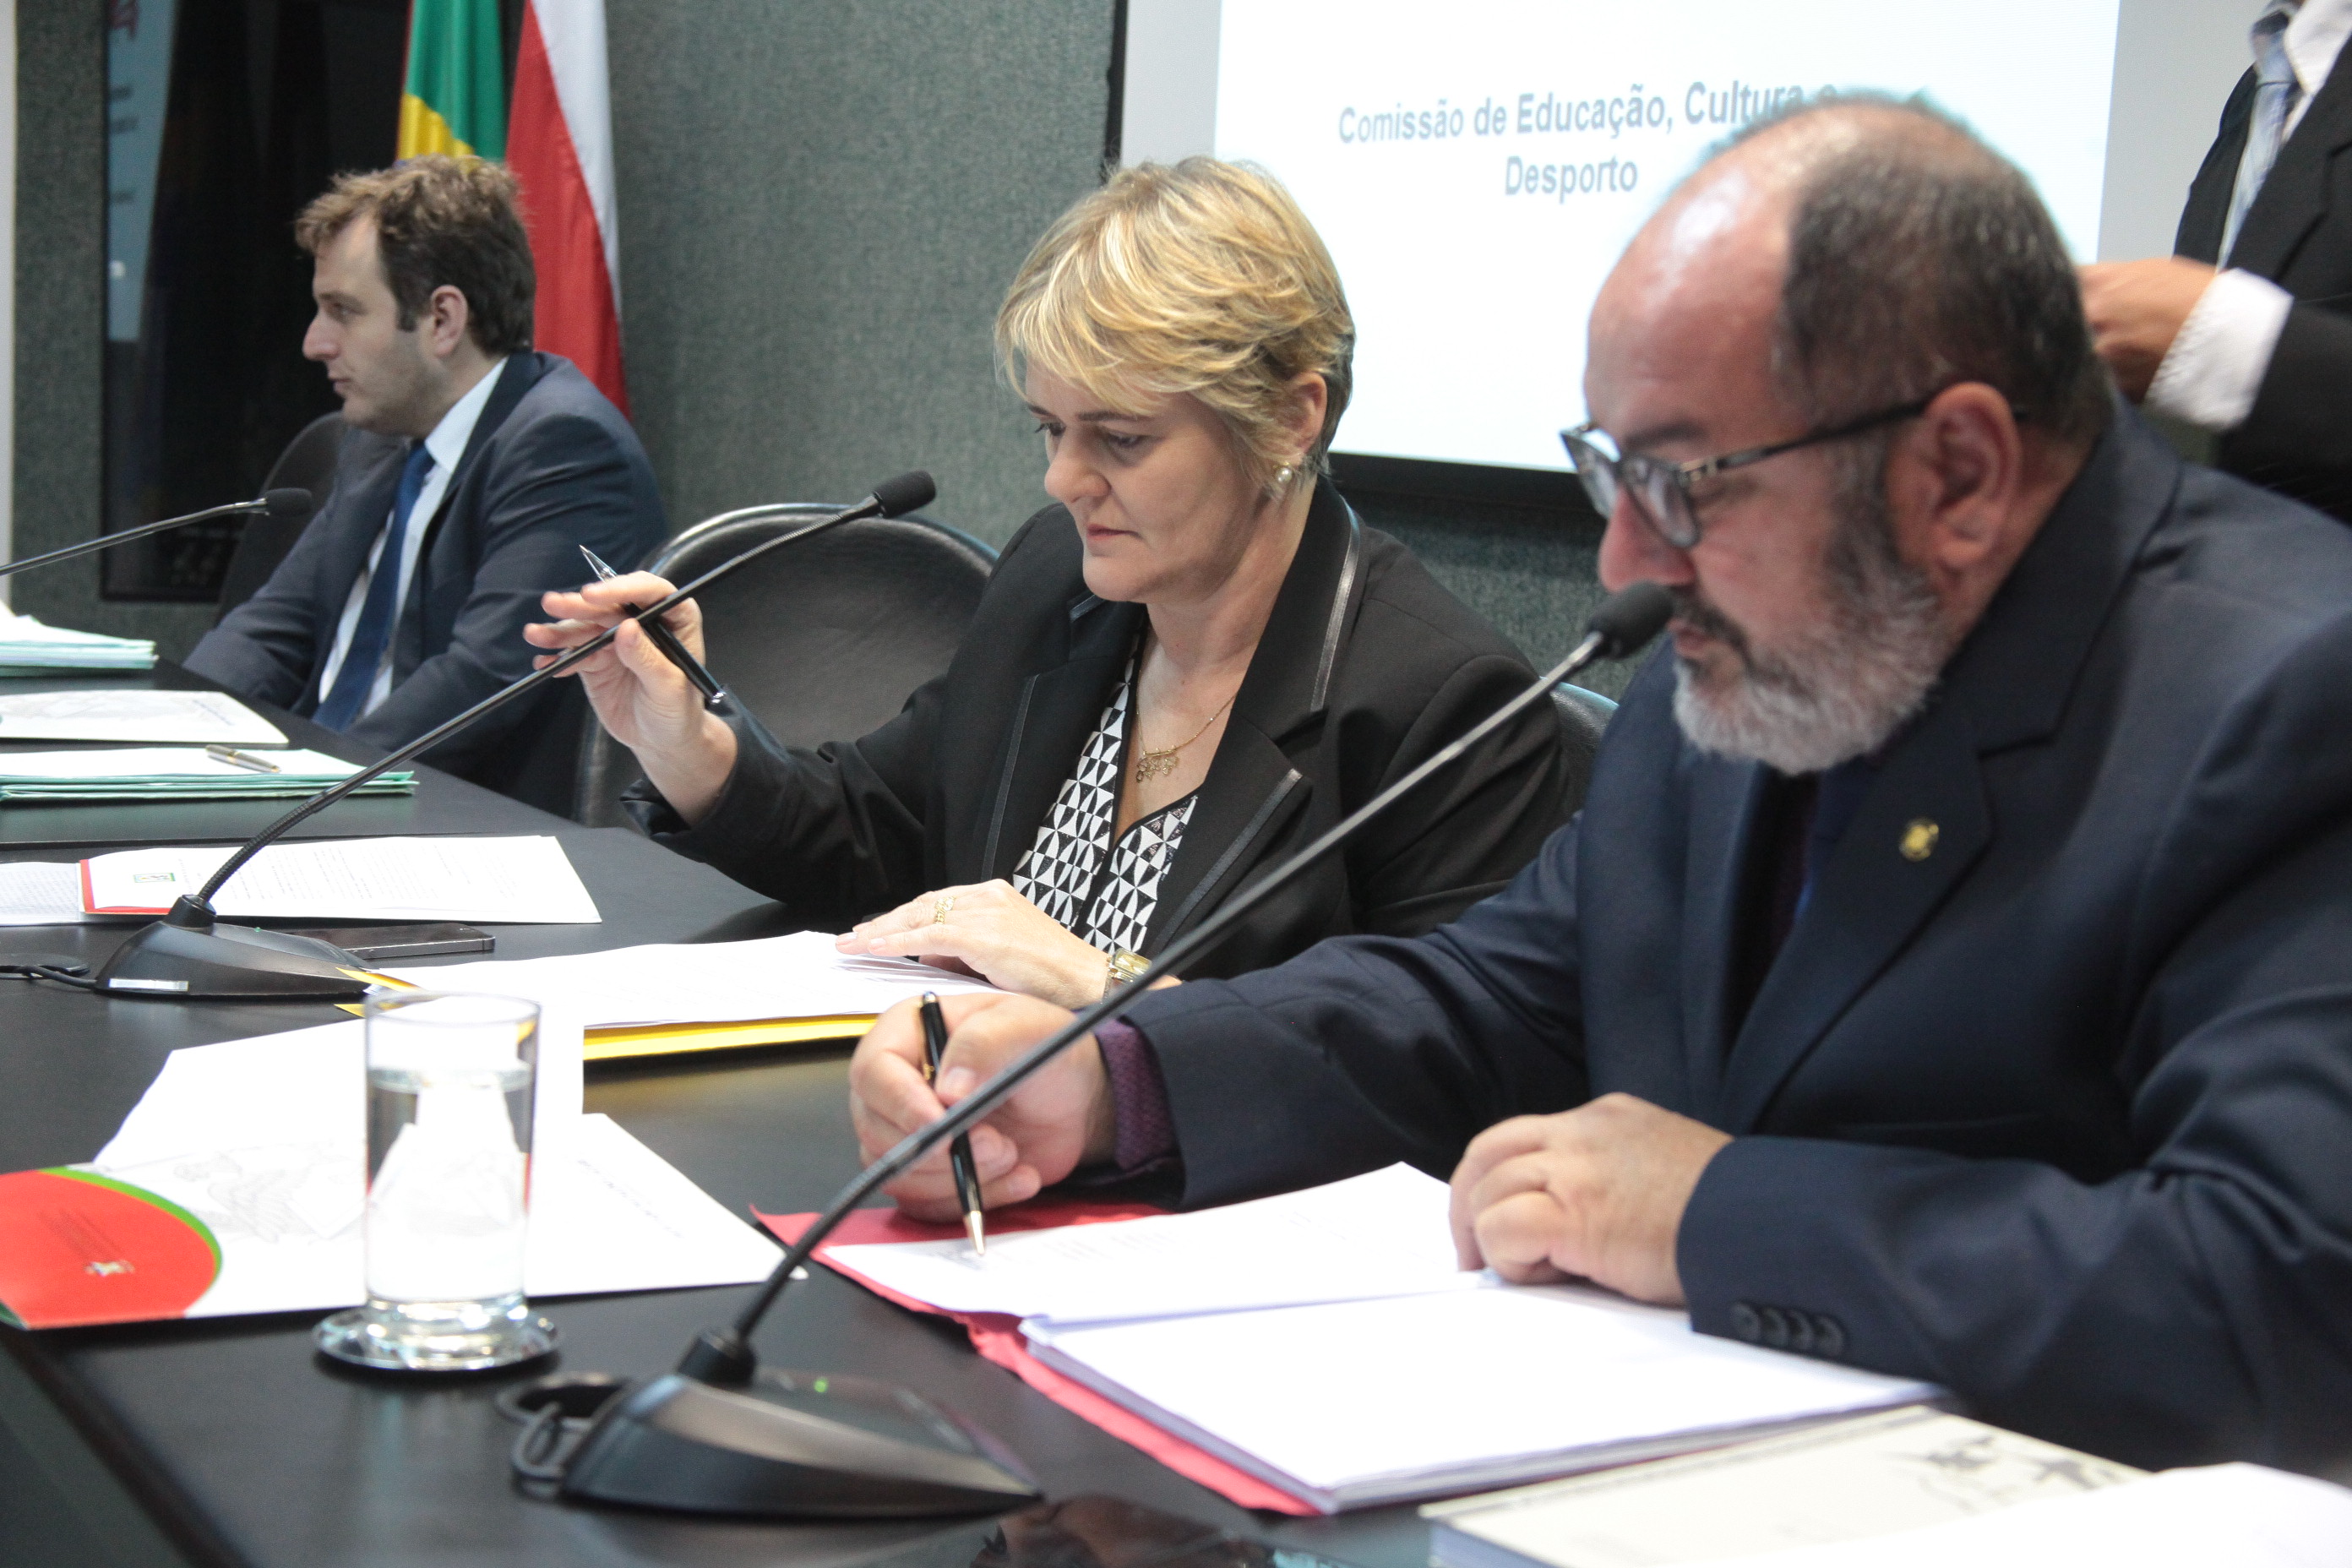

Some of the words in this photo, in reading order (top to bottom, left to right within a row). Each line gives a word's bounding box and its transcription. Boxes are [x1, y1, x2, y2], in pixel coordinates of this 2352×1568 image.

[1339, 98, 1464, 144] Comissão
[1474, 96, 1506, 135] de
[1516, 83, 1673, 139] Educação,
[1505, 155, 1638, 204] Desporto
